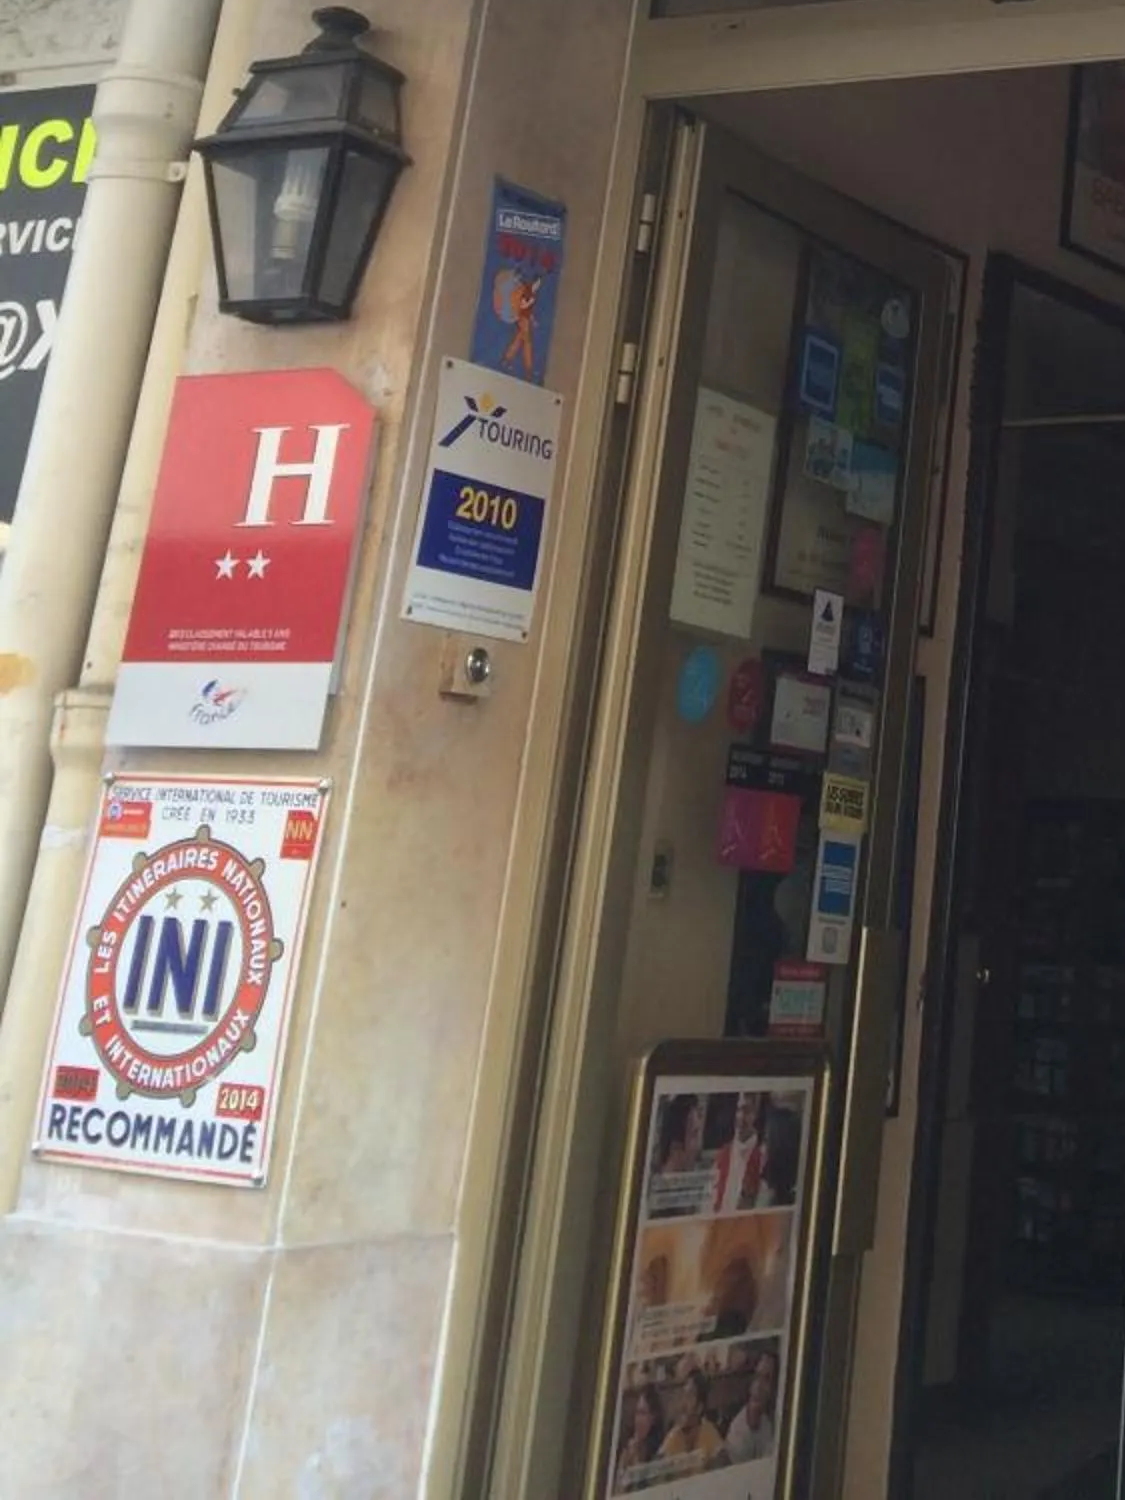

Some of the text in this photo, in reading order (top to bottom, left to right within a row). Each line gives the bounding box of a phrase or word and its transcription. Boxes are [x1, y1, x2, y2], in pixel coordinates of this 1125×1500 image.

[476, 417, 554, 462] TOURING
[232, 423, 351, 529] H
[456, 486, 518, 532] 2010
[156, 787, 237, 806] INTERNATIONAL
[240, 791, 254, 806] DE
[260, 791, 319, 809] TOURISME
[94, 847, 267, 985] LES ITINERAIRES NATIONAUX
[123, 914, 234, 1022] INI
[92, 995, 251, 1090] ET INTERNATIONAUX
[218, 1088, 260, 1111] 2014
[48, 1102, 257, 1163] RECOMMANDÉ
